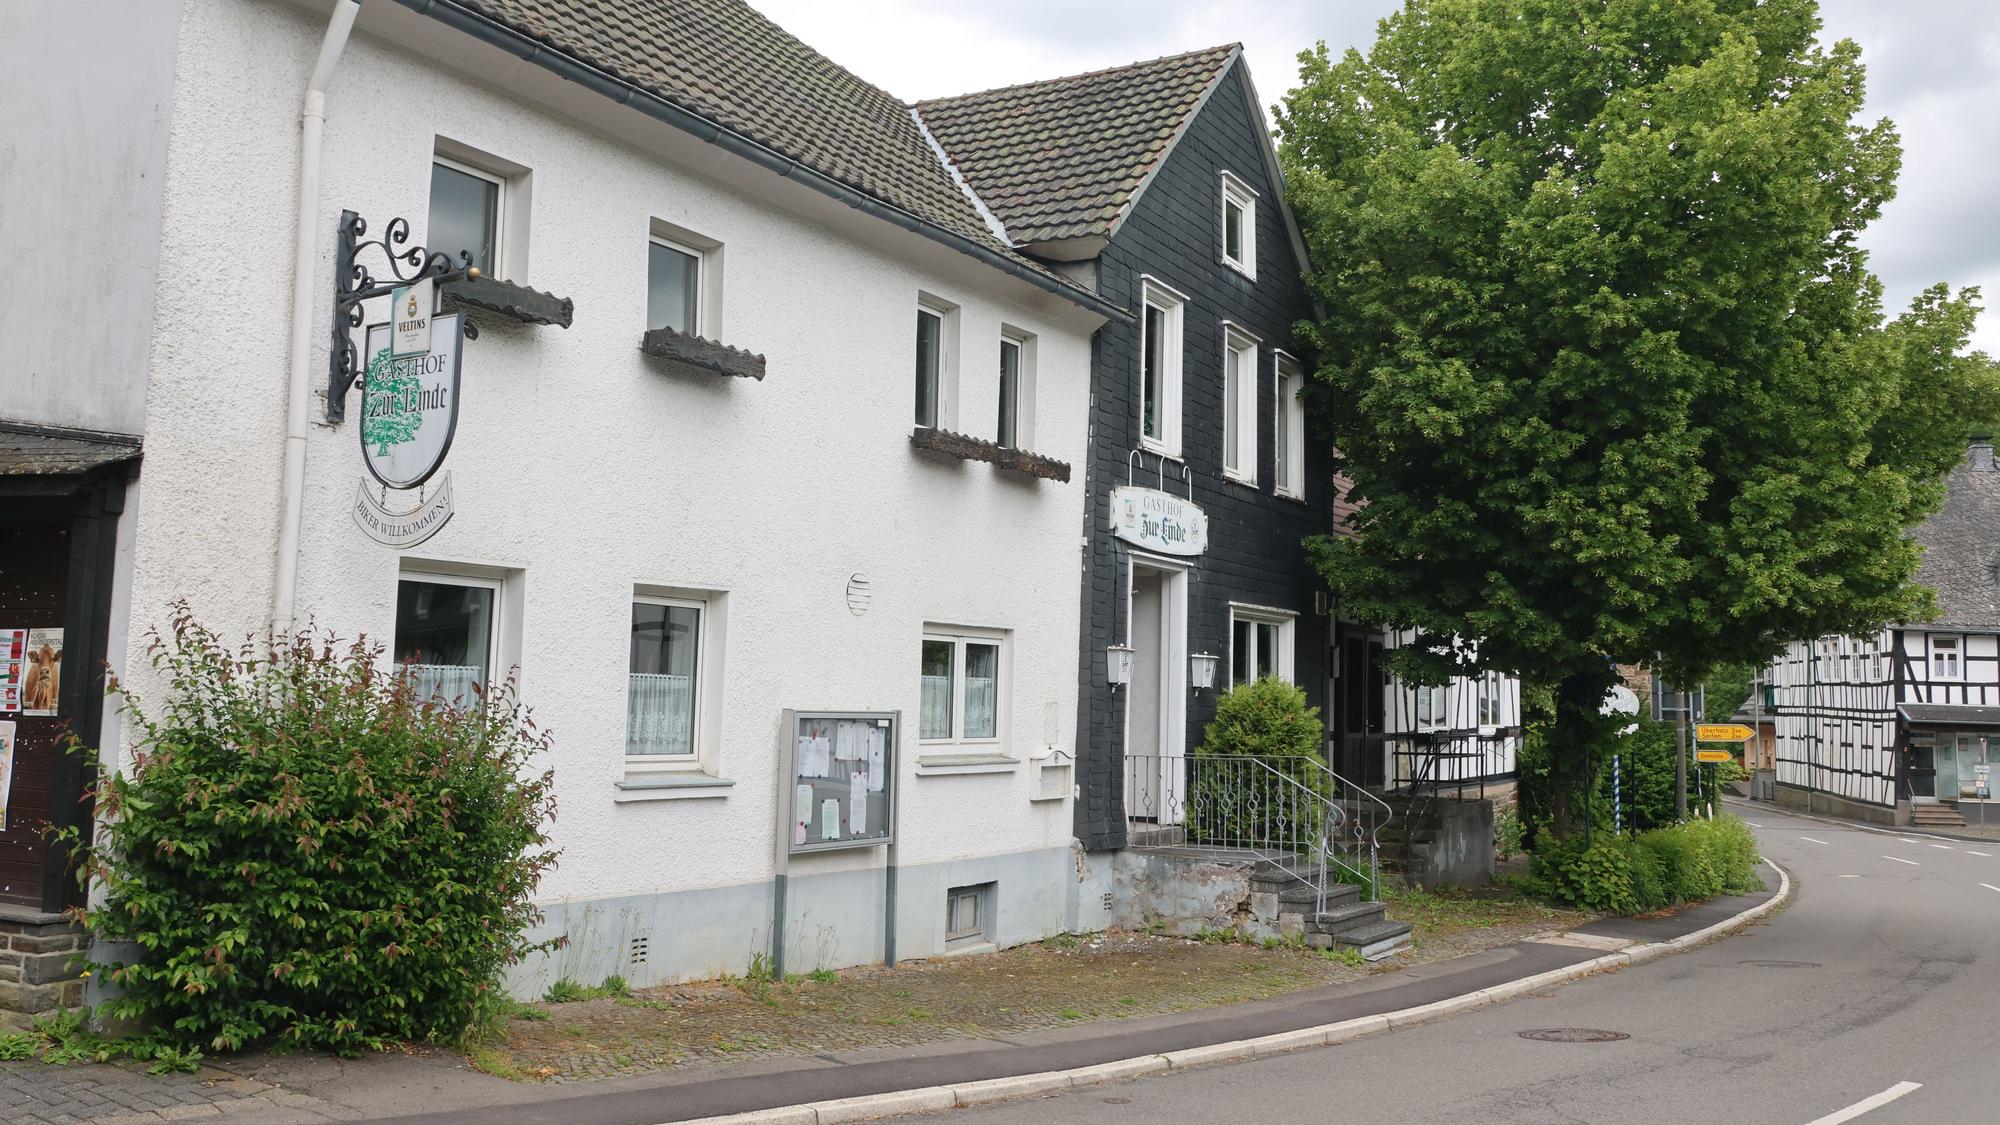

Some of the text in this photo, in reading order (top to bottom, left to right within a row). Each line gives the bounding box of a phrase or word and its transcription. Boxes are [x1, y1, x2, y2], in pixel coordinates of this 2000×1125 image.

[398, 318, 426, 333] VELTINS
[374, 354, 447, 382] GASTHOF
[369, 382, 448, 418] Zur Linde
[357, 496, 450, 537] BIKER WILLKOMMEN!
[1143, 495, 1184, 518] GASTHOF
[1140, 512, 1187, 546] Zur Linde
